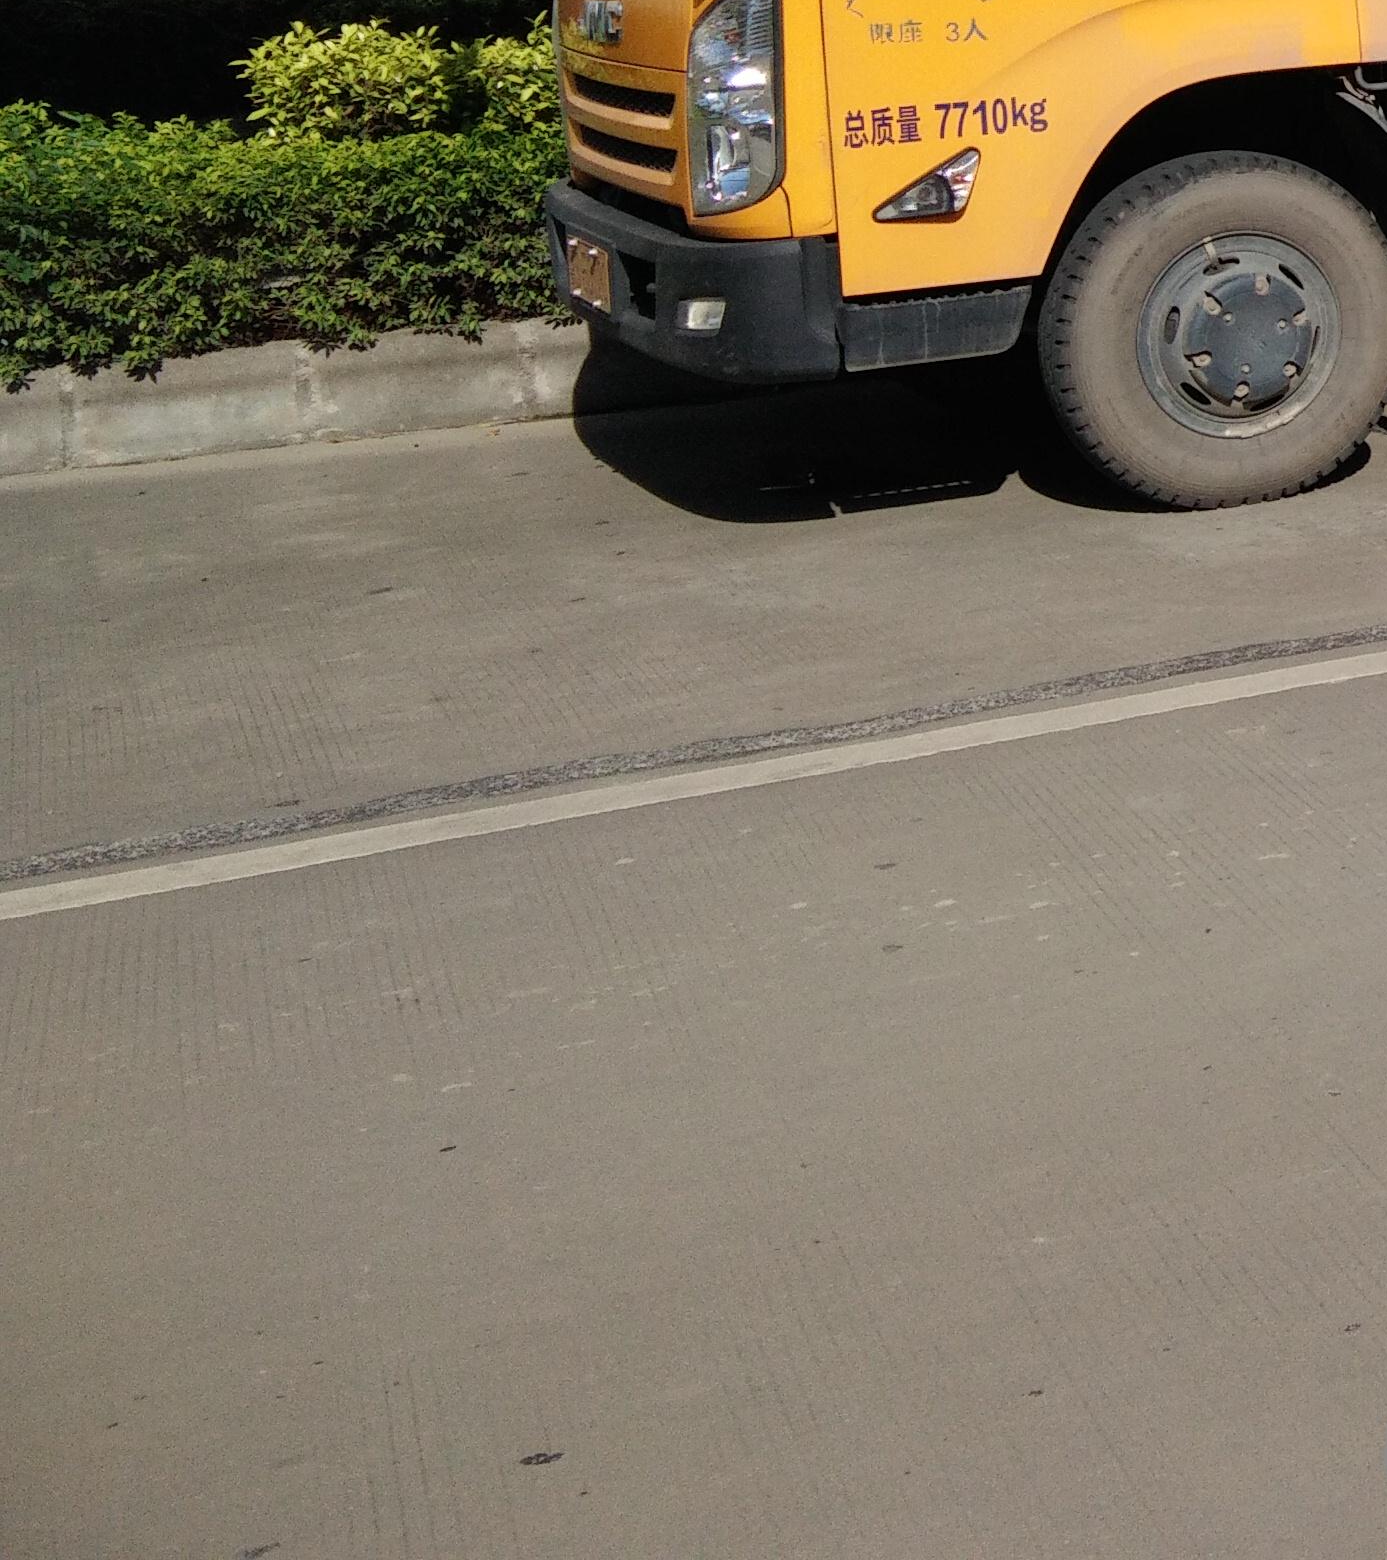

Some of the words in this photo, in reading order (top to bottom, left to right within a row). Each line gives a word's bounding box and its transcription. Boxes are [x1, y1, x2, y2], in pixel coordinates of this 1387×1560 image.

[945, 17, 988, 42] 3人
[844, 104, 922, 149] 总质量
[934, 97, 1048, 139] 7710kg
